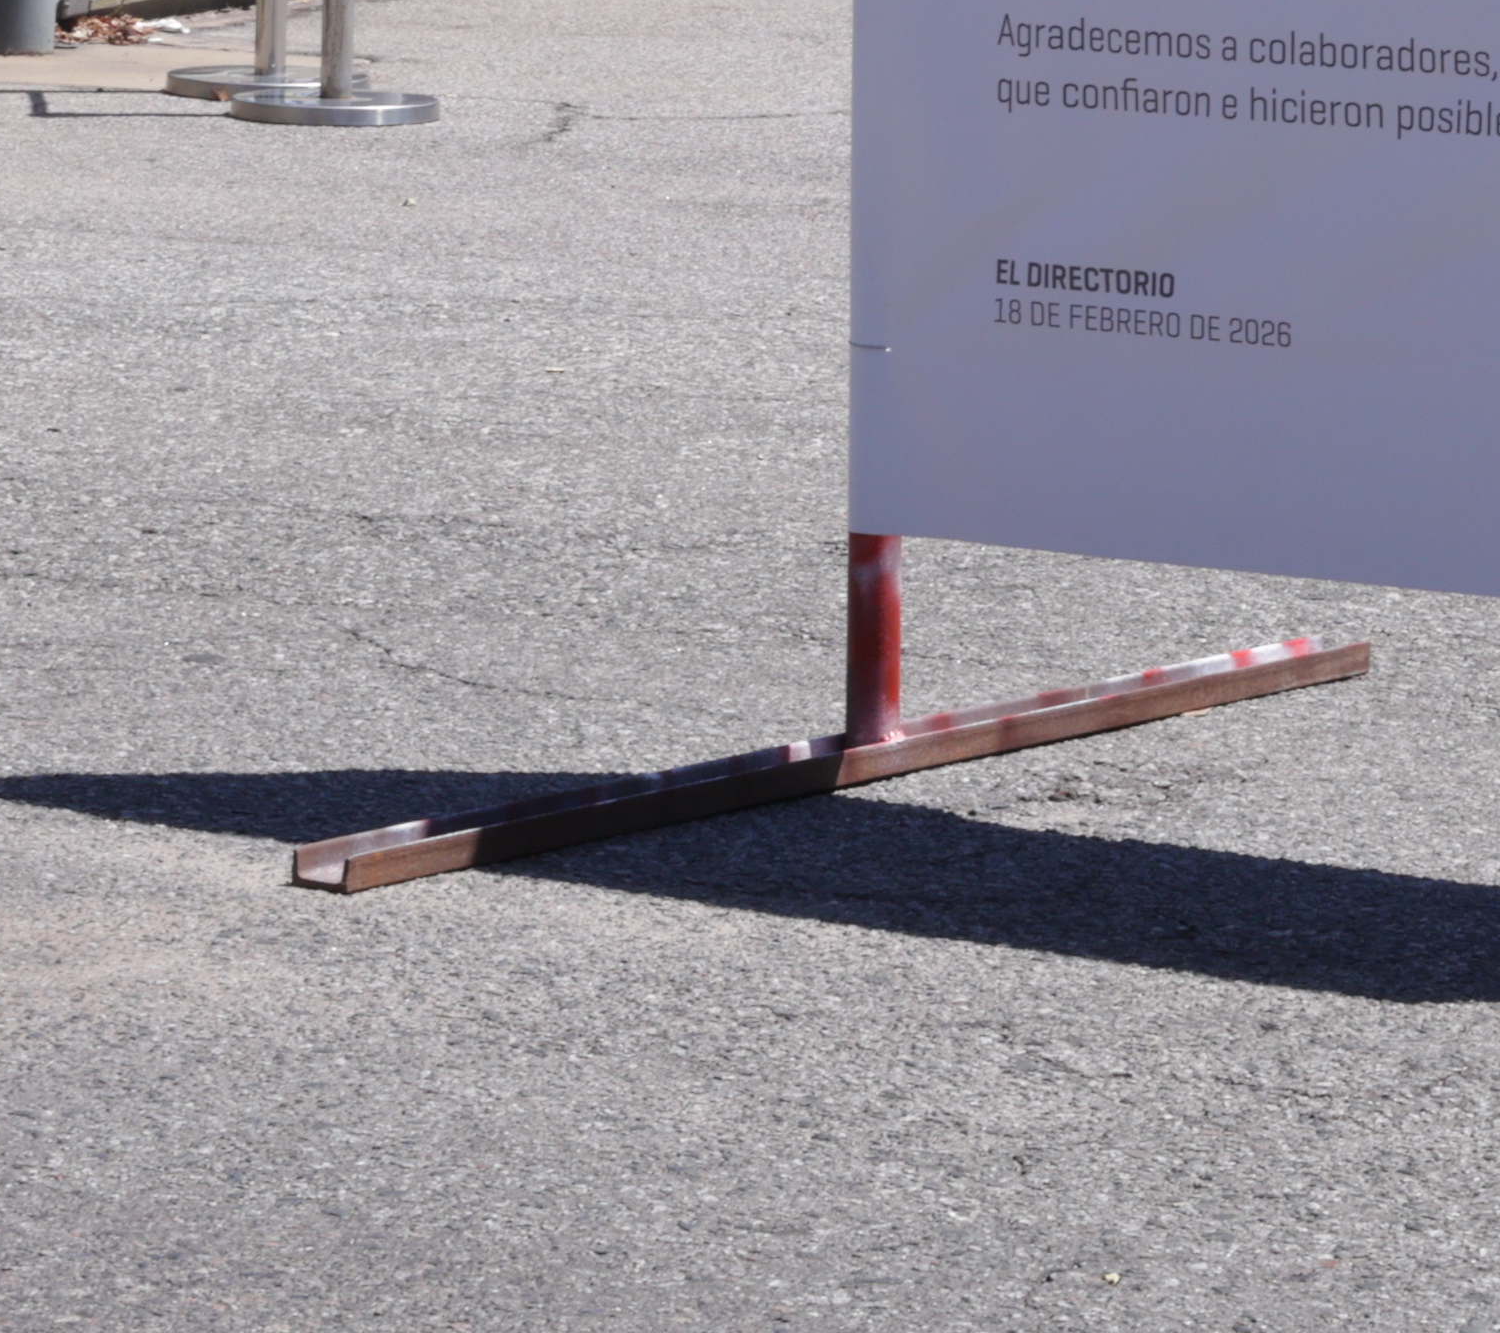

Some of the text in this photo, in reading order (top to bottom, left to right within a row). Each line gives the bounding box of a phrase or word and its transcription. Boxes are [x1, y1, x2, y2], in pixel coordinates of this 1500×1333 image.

[997, 13, 1211, 60] Agradecemos
[1221, 35, 1237, 62] a
[1249, 30, 1498, 82] colaboradores,
[997, 78, 1050, 113] que
[1062, 77, 1211, 118] confiaron
[1221, 93, 1238, 120] e
[1250, 86, 1384, 129] hicieron
[995, 258, 1175, 299] EL DIRECTORIO
[994, 297, 1292, 348] 18 DE FEBRERO DE 2026
